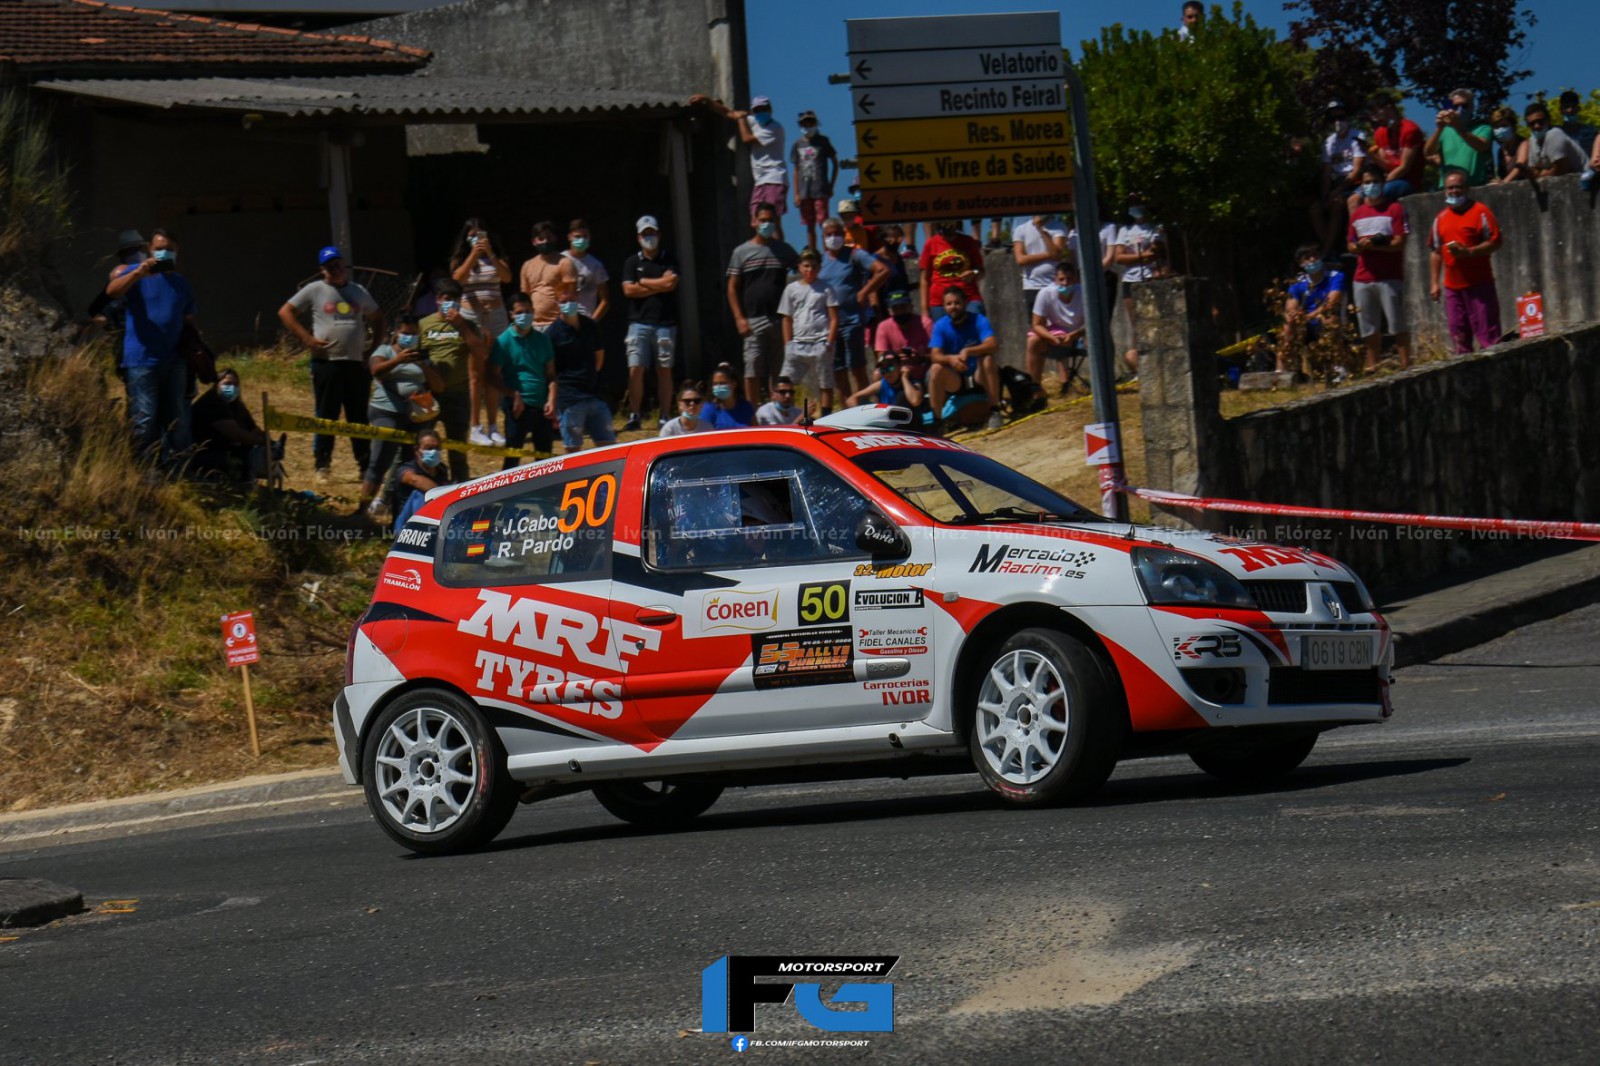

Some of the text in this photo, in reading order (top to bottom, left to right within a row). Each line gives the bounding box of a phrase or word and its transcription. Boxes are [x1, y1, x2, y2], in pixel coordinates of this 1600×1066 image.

[979, 50, 1058, 75] Velatorio
[940, 83, 1061, 111] Recinto Feiral
[967, 119, 1064, 143] Res. Morea
[892, 149, 1066, 181] Res. Virxe da Saúde
[892, 191, 1071, 214] Área de autocaravanas
[478, 479, 510, 493] MARIA
[511, 473, 526, 483] DE
[557, 474, 616, 534] 50
[397, 527, 431, 548] BRAVE
[497, 536, 574, 559] R. Pardo
[968, 543, 1076, 574] Mercado
[801, 584, 846, 622] 50
[855, 590, 910, 605] EVOLUCION
[457, 588, 662, 674] MRF
[859, 637, 926, 646] FIDEL CANALES
[1312, 640, 1370, 665] 0619 CBN
[475, 649, 624, 720] TYRES
[863, 678, 930, 690] Carrocerias
[882, 689, 931, 706] IVOR
